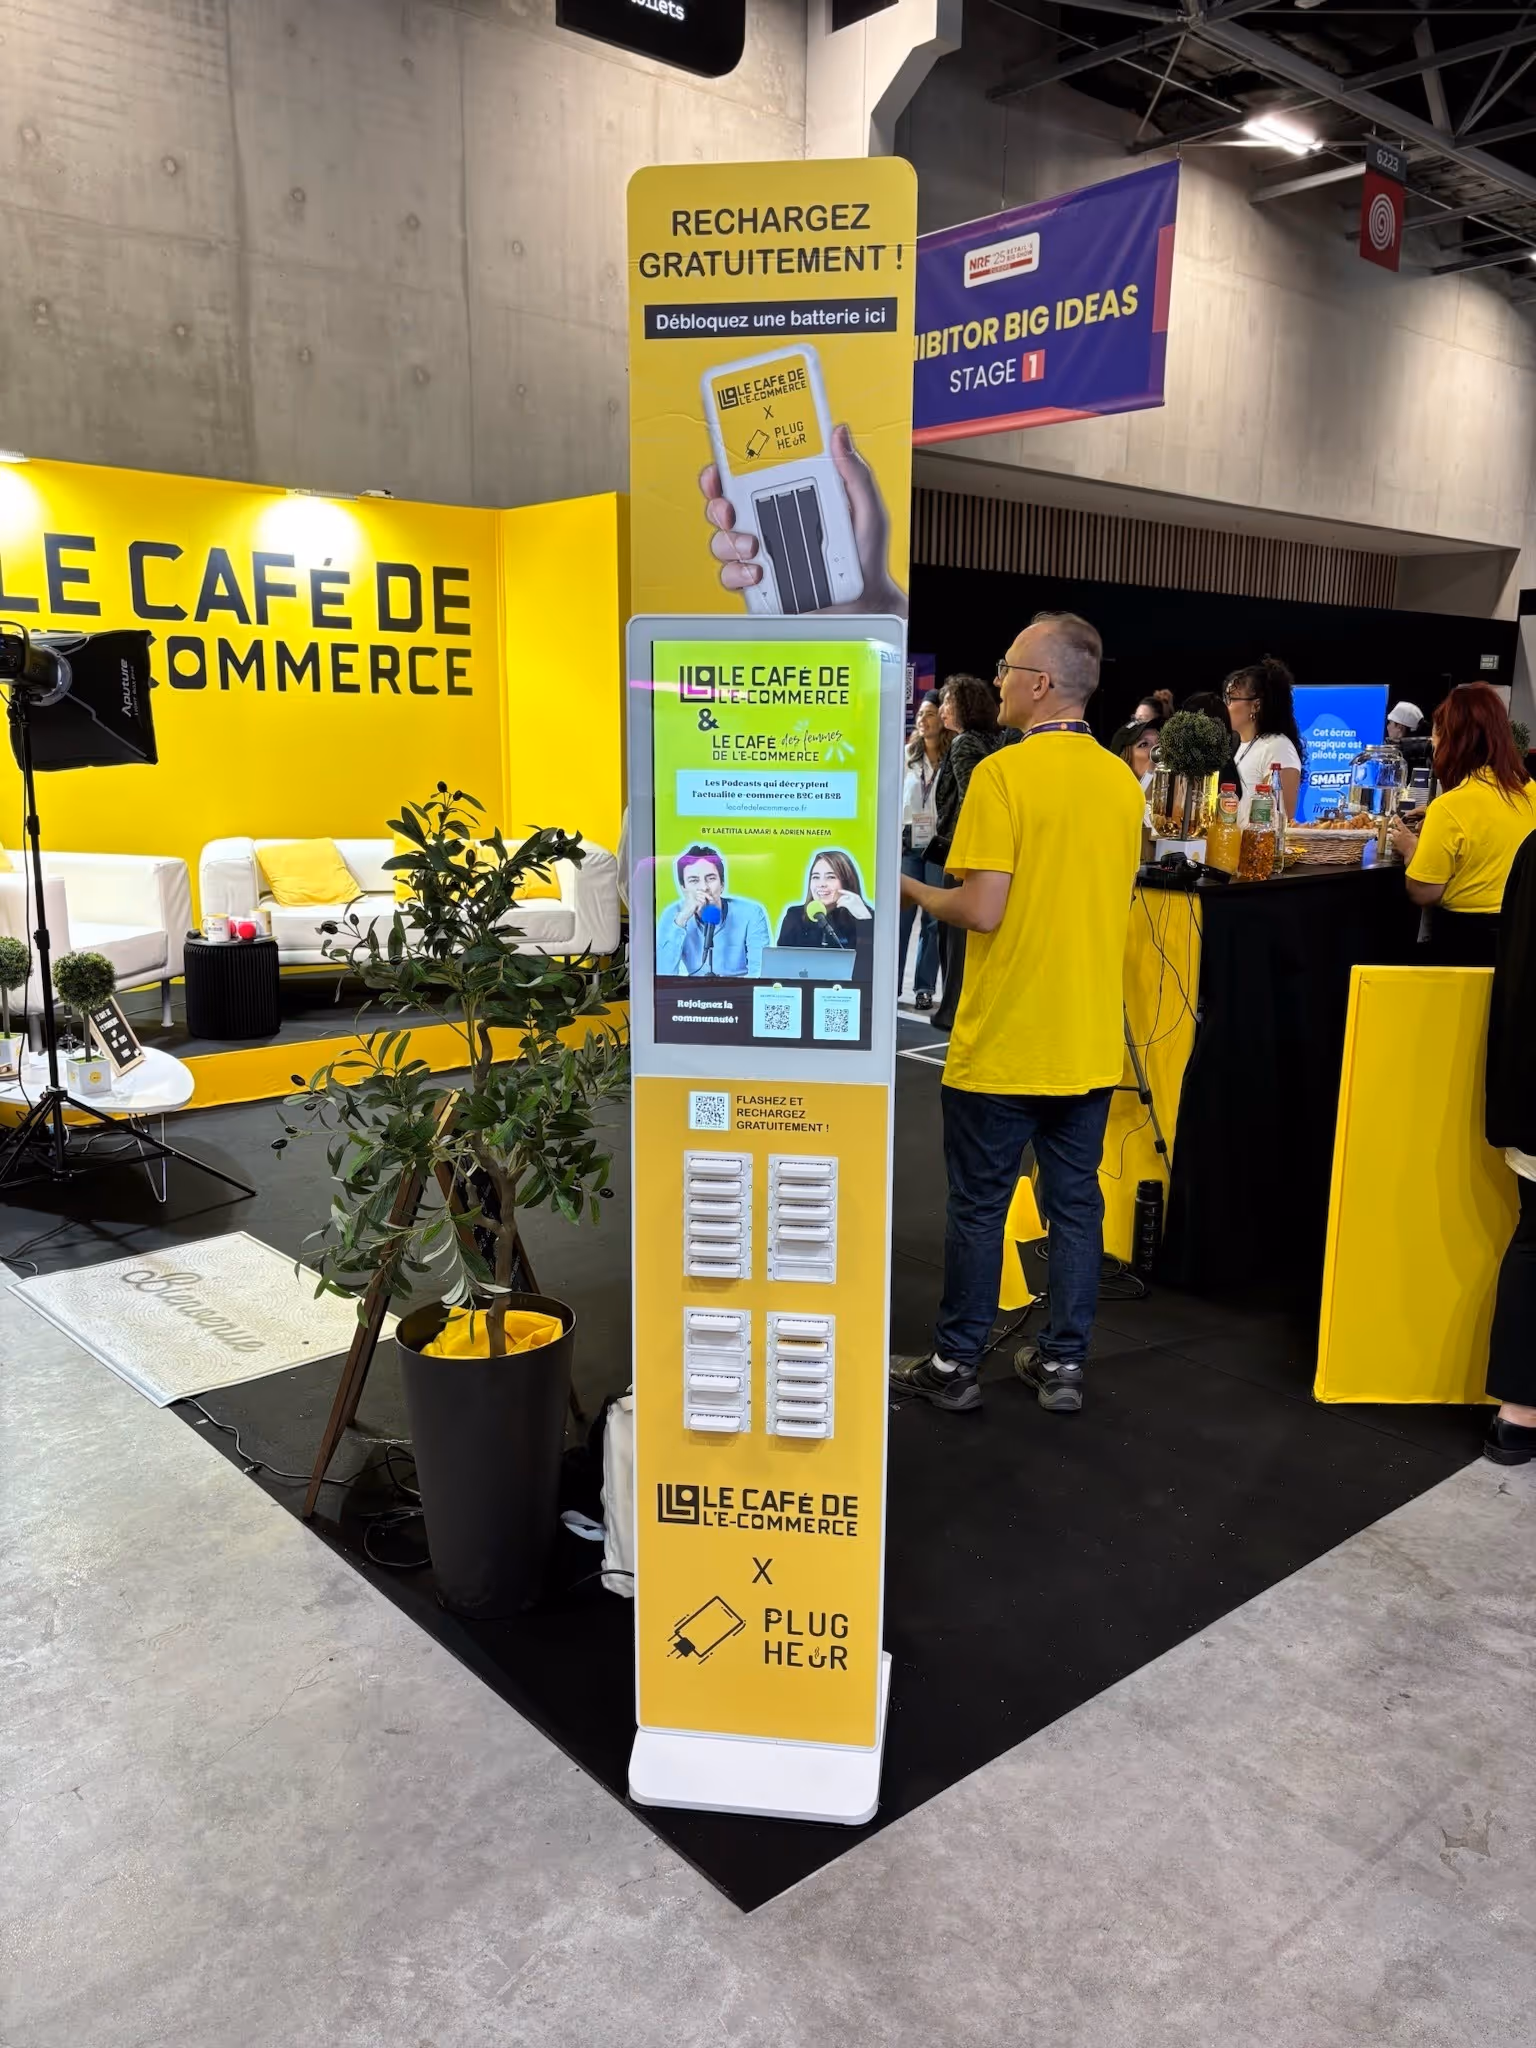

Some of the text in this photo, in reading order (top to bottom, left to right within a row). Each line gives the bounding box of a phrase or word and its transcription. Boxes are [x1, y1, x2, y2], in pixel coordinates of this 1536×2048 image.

[1376, 149, 1399, 173] 6223
[672, 203, 870, 236] RECHARGEZ
[638, 244, 903, 279] GRATUITEMENT !
[969, 254, 992, 271] NRF
[656, 307, 886, 332] Débloquez une batterie ici
[1004, 305, 1049, 342] BIG
[1055, 284, 1139, 330] IDEAS
[737, 368, 805, 396] LE CAFÉ DE
[950, 353, 1038, 393] STAGE 1
[739, 380, 807, 405] L'E-COMMERCE
[763, 405, 774, 420] X
[774, 421, 804, 438] PLUG
[128, 540, 353, 630] CAFÉ
[376, 561, 471, 636] DE
[718, 666, 850, 687] LE CAFÉ DE
[120, 658, 132, 717] Aputure
[718, 689, 850, 704] L'E-COMMERCE
[698, 708, 720, 731] &
[712, 729, 843, 751] LE CAFÉ des femmes
[1313, 728, 1356, 737] Cet écran
[1307, 740, 1362, 750] magique est
[712, 751, 820, 762] DE L'E-COMMERCE
[1311, 750, 1356, 762] piloté par
[705, 779, 829, 789] Les Podcasts qui décryptent
[1311, 772, 1351, 785] SMART
[692, 790, 736, 799] l'actualité
[796, 792, 814, 800] B2C
[712, 827, 743, 835] LAETITIA
[780, 828, 802, 836] ADRIEN
[677, 999, 734, 1010] Rejoignez la
[671, 1014, 735, 1024] communauté
[736, 1095, 803, 1106] FLASHEZ ET
[736, 1108, 806, 1119] RECHARGEZ
[736, 1120, 823, 1133] GRATUITEMENT
[121, 1269, 266, 1353] Bienvenue
[703, 1486, 859, 1518] LE CAFÉ DE
[703, 1511, 858, 1537] L'E-COMMERCE
[752, 1556, 773, 1585] X
[764, 1607, 848, 1639] PLUG
